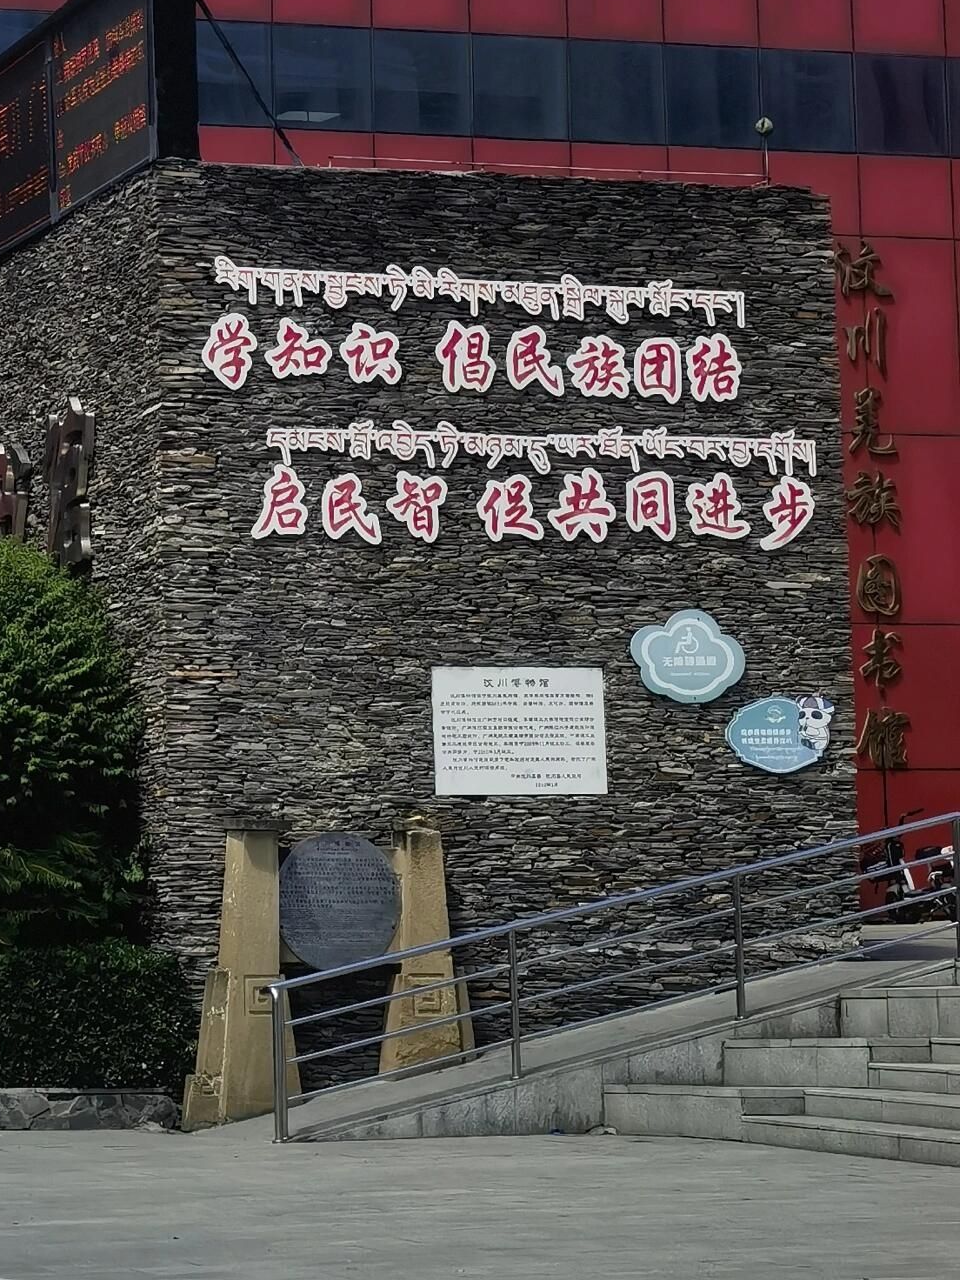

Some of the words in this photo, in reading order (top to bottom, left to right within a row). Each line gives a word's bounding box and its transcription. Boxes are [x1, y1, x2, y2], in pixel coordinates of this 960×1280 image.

[202, 313, 402, 390] 学知识
[435, 320, 742, 404] 倡民族团结
[251, 464, 448, 544] 启民智
[477, 468, 815, 550] 促共同进步
